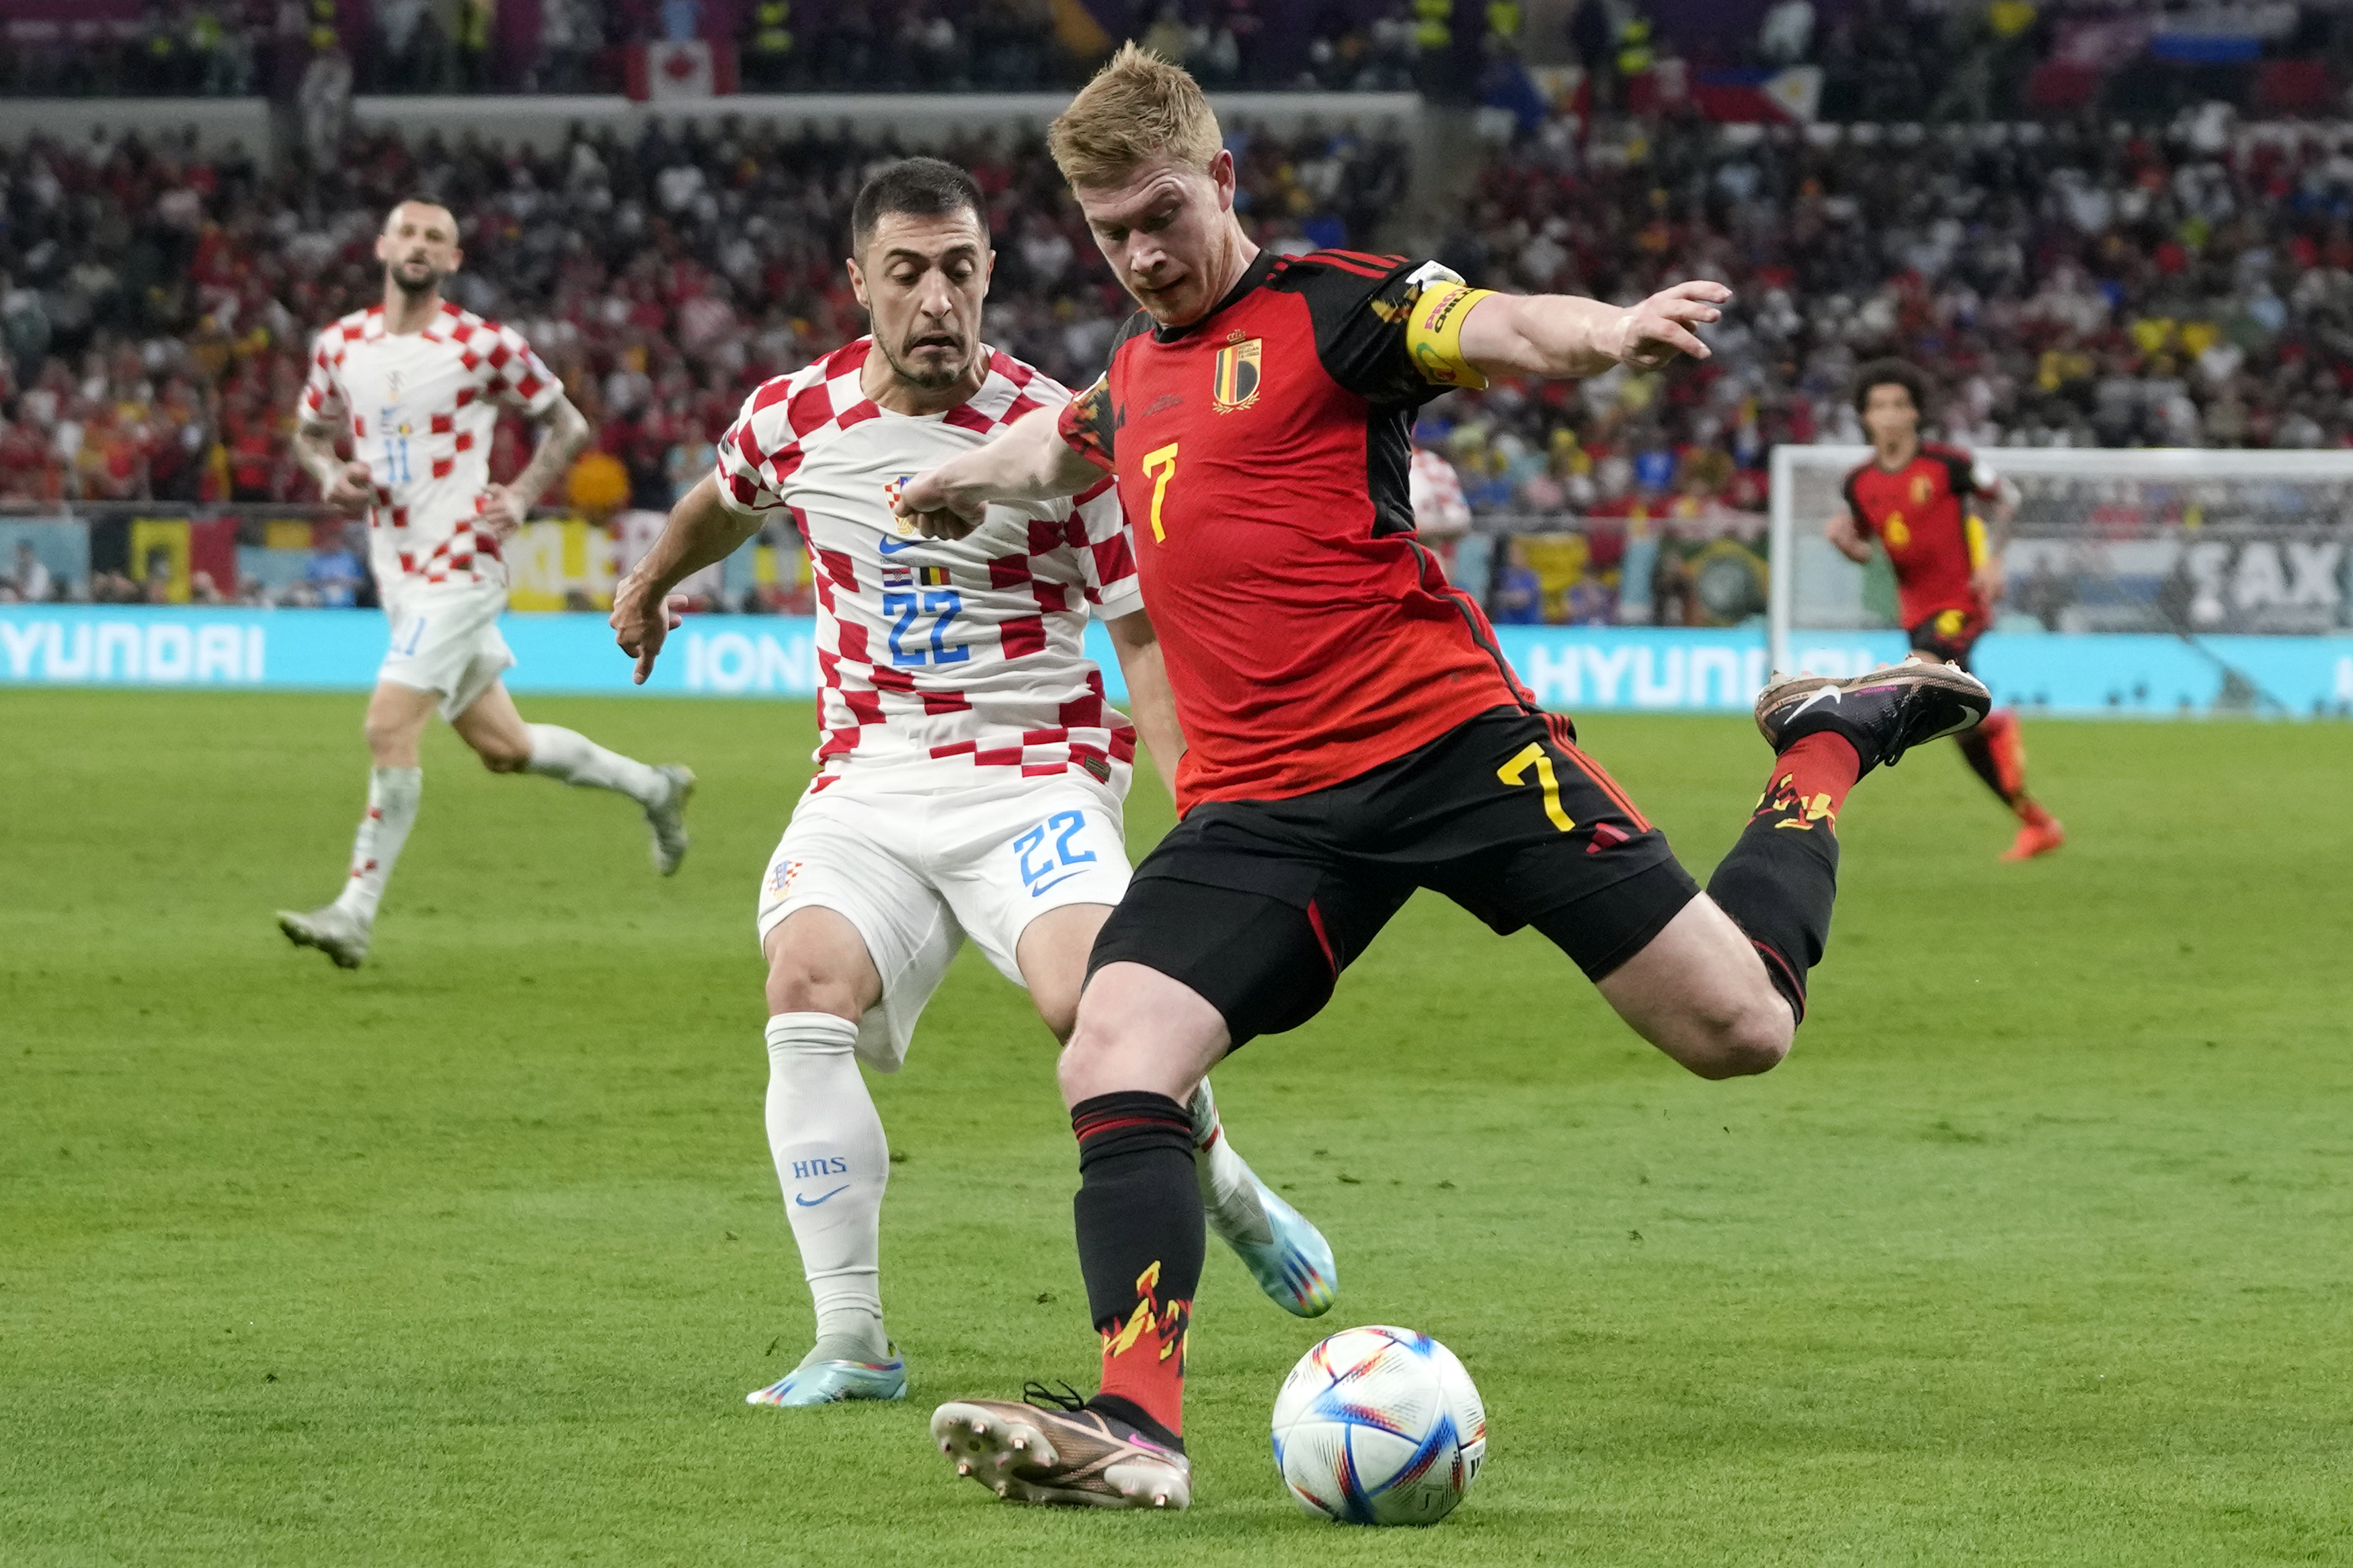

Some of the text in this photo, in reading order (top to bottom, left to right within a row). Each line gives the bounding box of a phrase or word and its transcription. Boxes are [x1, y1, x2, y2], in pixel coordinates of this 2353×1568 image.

[385, 439, 411, 483] 11
[1142, 442, 1179, 544] 7
[1884, 509, 1911, 549] 6
[0, 620, 265, 681] YUNDAI
[883, 589, 970, 666] 22
[686, 631, 817, 692] ION
[1496, 741, 1577, 832] 7
[1013, 809, 1098, 888] 22
[792, 1157, 847, 1179] HNS
